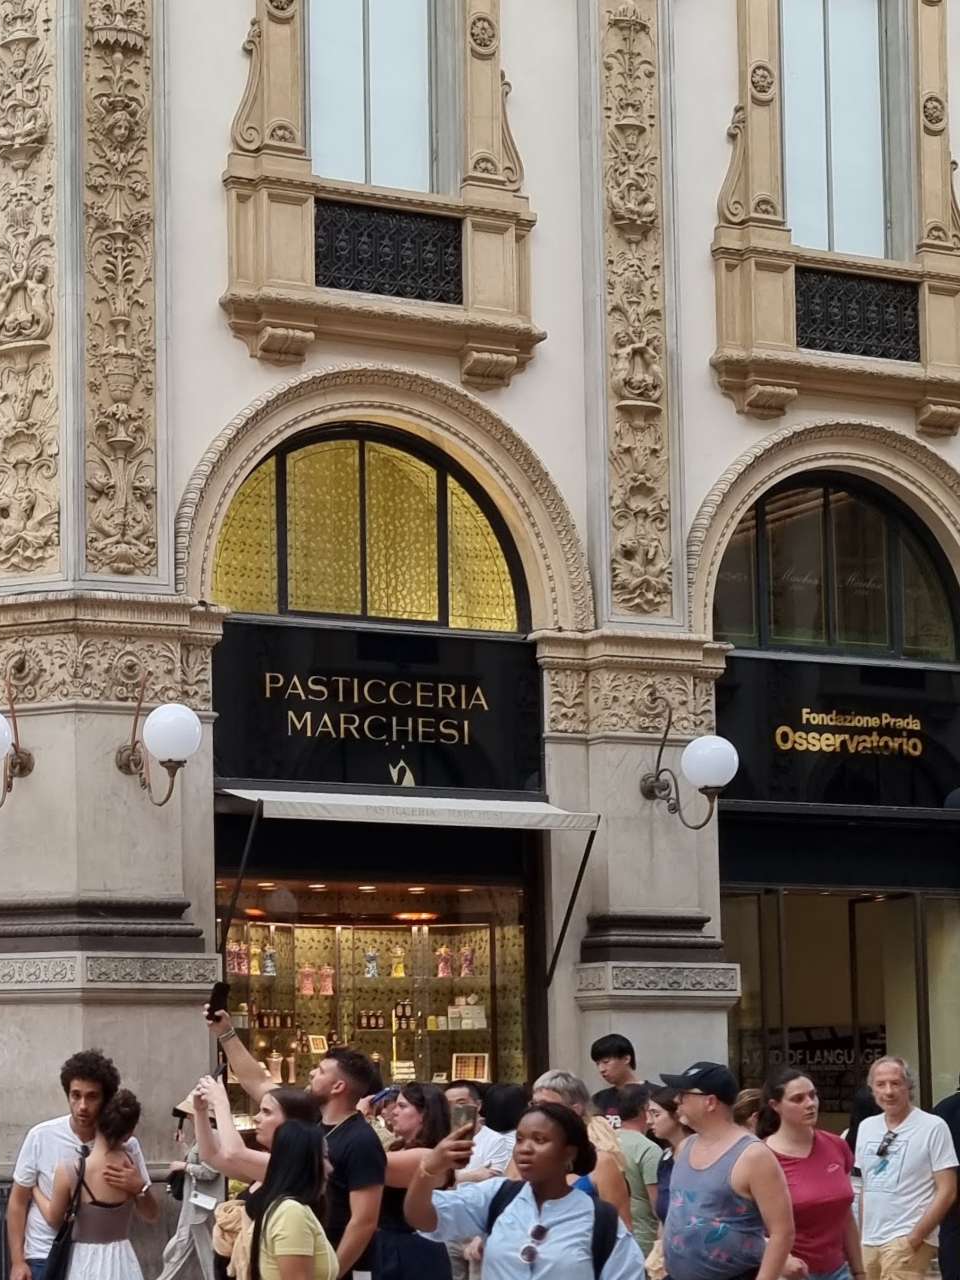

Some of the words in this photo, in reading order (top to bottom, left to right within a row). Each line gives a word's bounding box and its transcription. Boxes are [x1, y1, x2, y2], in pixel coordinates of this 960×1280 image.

[265, 672, 489, 711] PASTICCERIA
[287, 710, 470, 745] MARCHESI
[801, 706, 880, 727] Fondazione
[882, 712, 921, 731] Prada
[775, 724, 923, 757] Osservatorio
